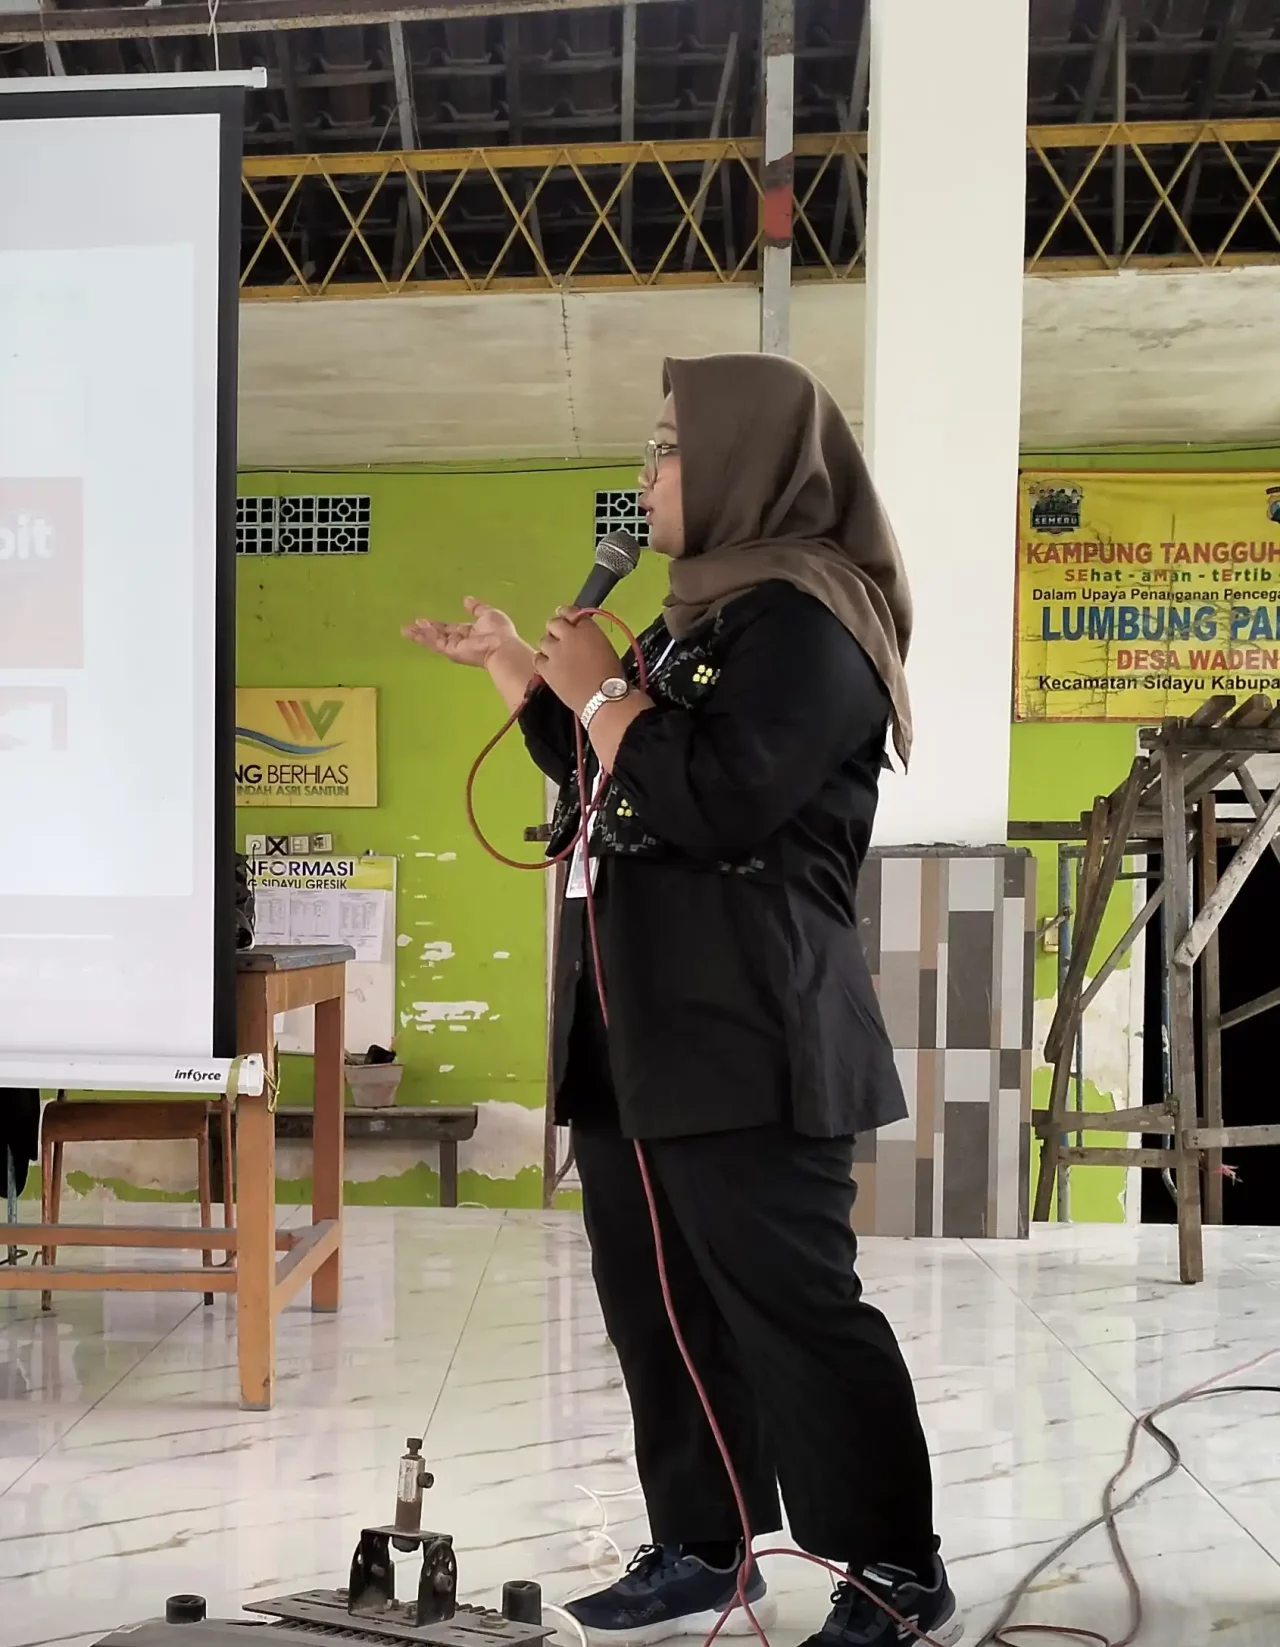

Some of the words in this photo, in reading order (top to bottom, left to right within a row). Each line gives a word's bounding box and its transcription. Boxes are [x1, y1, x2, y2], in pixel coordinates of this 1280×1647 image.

[1034, 517, 1077, 525] SEMERU
[1026, 542, 1153, 564] KAMPUNG
[1160, 541, 1280, 564] TANGGUH
[1064, 568, 1122, 582] SEhat
[1141, 569, 1192, 582] aMan
[1211, 567, 1272, 582] tErtib
[1032, 588, 1077, 601] Dalam
[1081, 588, 1127, 602] Upaya
[1130, 588, 1219, 603] Penanganan
[1041, 606, 1218, 641] LUMBUNG
[1230, 605, 1280, 641] PA
[1116, 649, 1181, 670] DESA
[1188, 649, 1280, 670] WADEN
[1038, 675, 1138, 690] Kecamatan
[1143, 675, 1205, 693] Sidayu
[1211, 675, 1280, 693] Kabupa
[267, 764, 349, 784] BERHIAS
[236, 785, 272, 796] INDAH
[276, 785, 302, 796] ASRI
[304, 785, 350, 796] SANTUN
[305, 879, 348, 889] GRESIK
